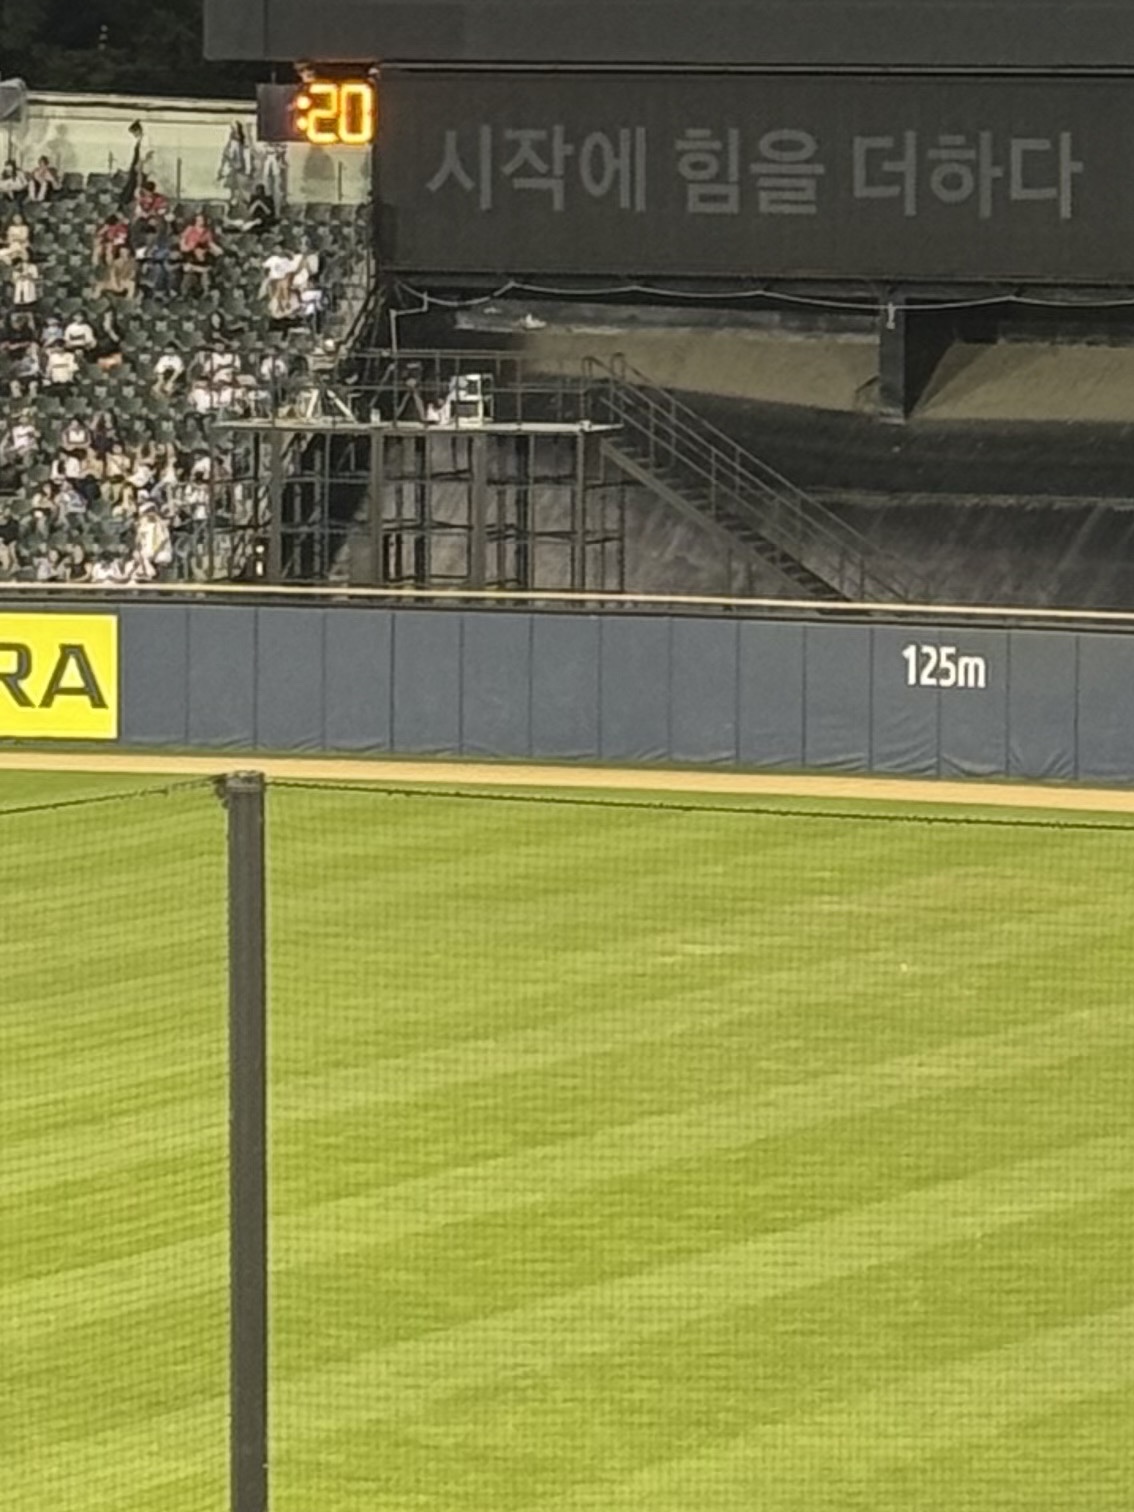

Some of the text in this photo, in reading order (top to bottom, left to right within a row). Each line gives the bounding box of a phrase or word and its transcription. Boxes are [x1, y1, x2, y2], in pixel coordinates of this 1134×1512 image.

[426, 123, 1084, 221] 시작에 힘을 더하다
[902, 643, 986, 689] 125m
